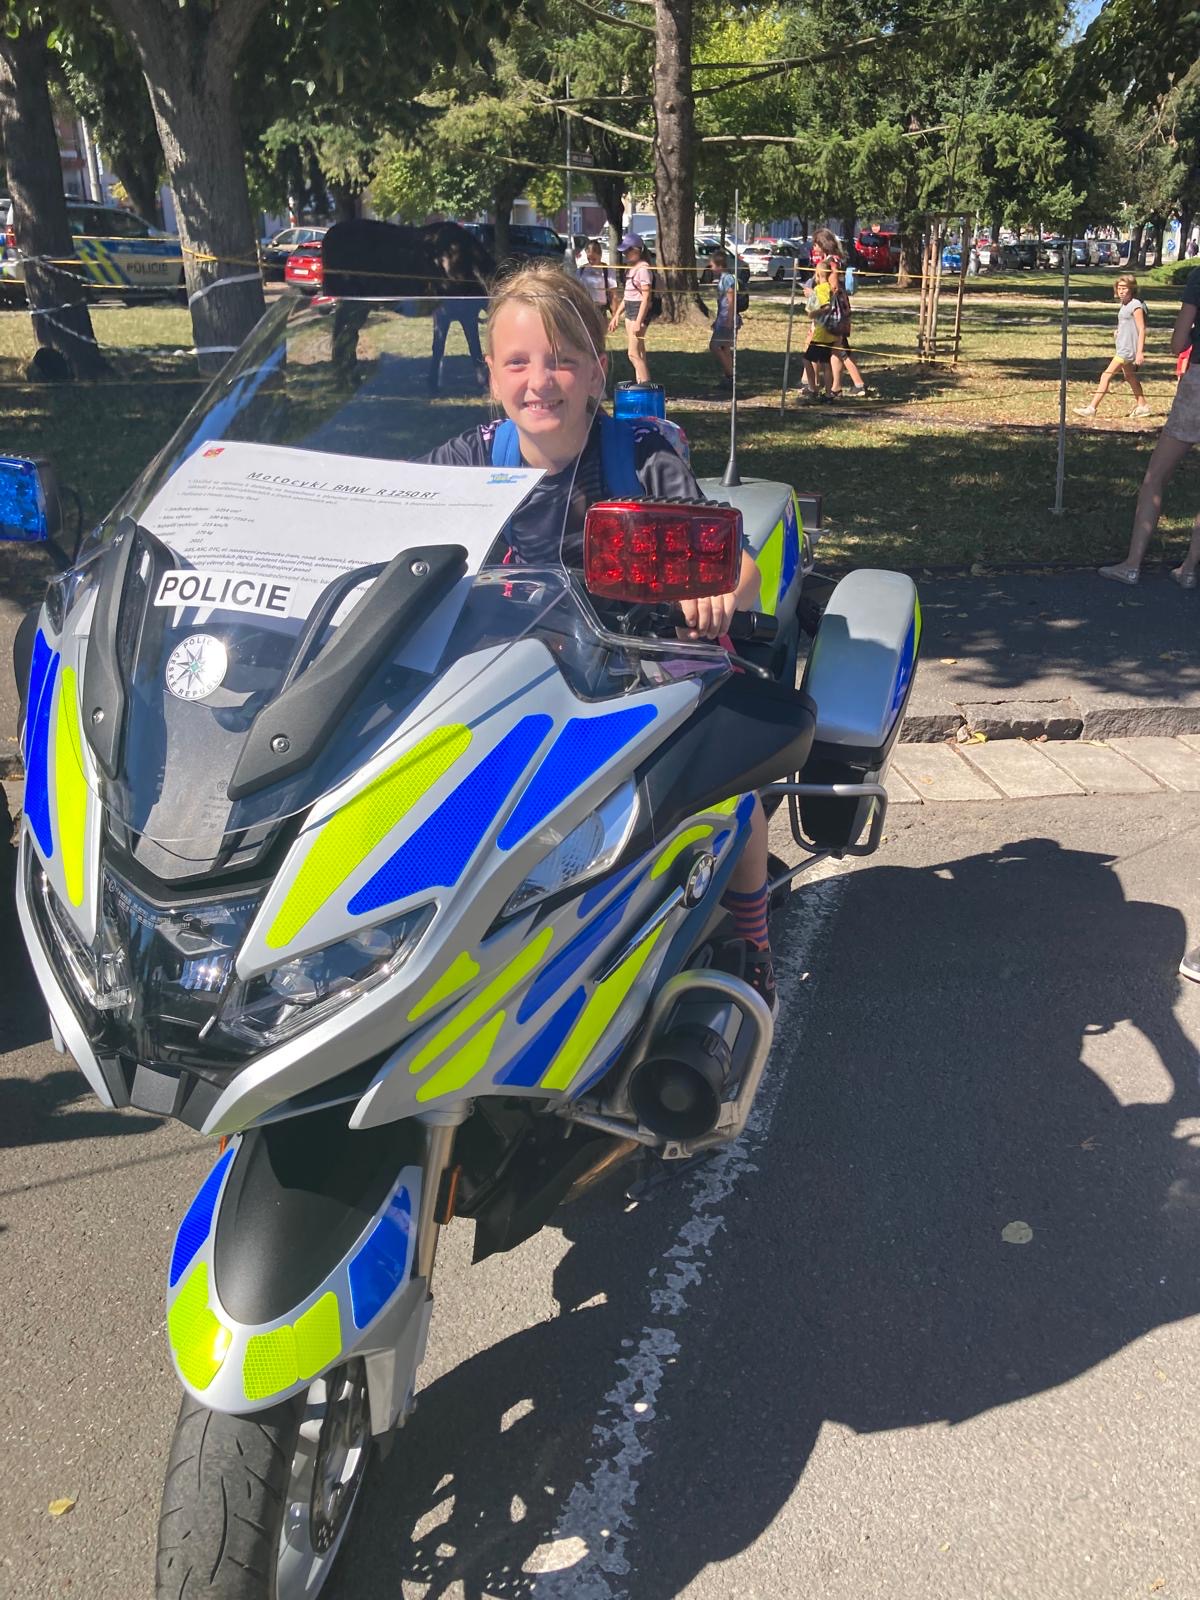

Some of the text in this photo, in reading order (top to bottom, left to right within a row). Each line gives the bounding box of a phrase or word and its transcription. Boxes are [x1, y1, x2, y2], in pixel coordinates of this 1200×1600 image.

[248, 472, 327, 489] Motocykl
[333, 484, 370, 494] BMW
[376, 488, 387, 496] R
[159, 575, 292, 612] POLICIE
